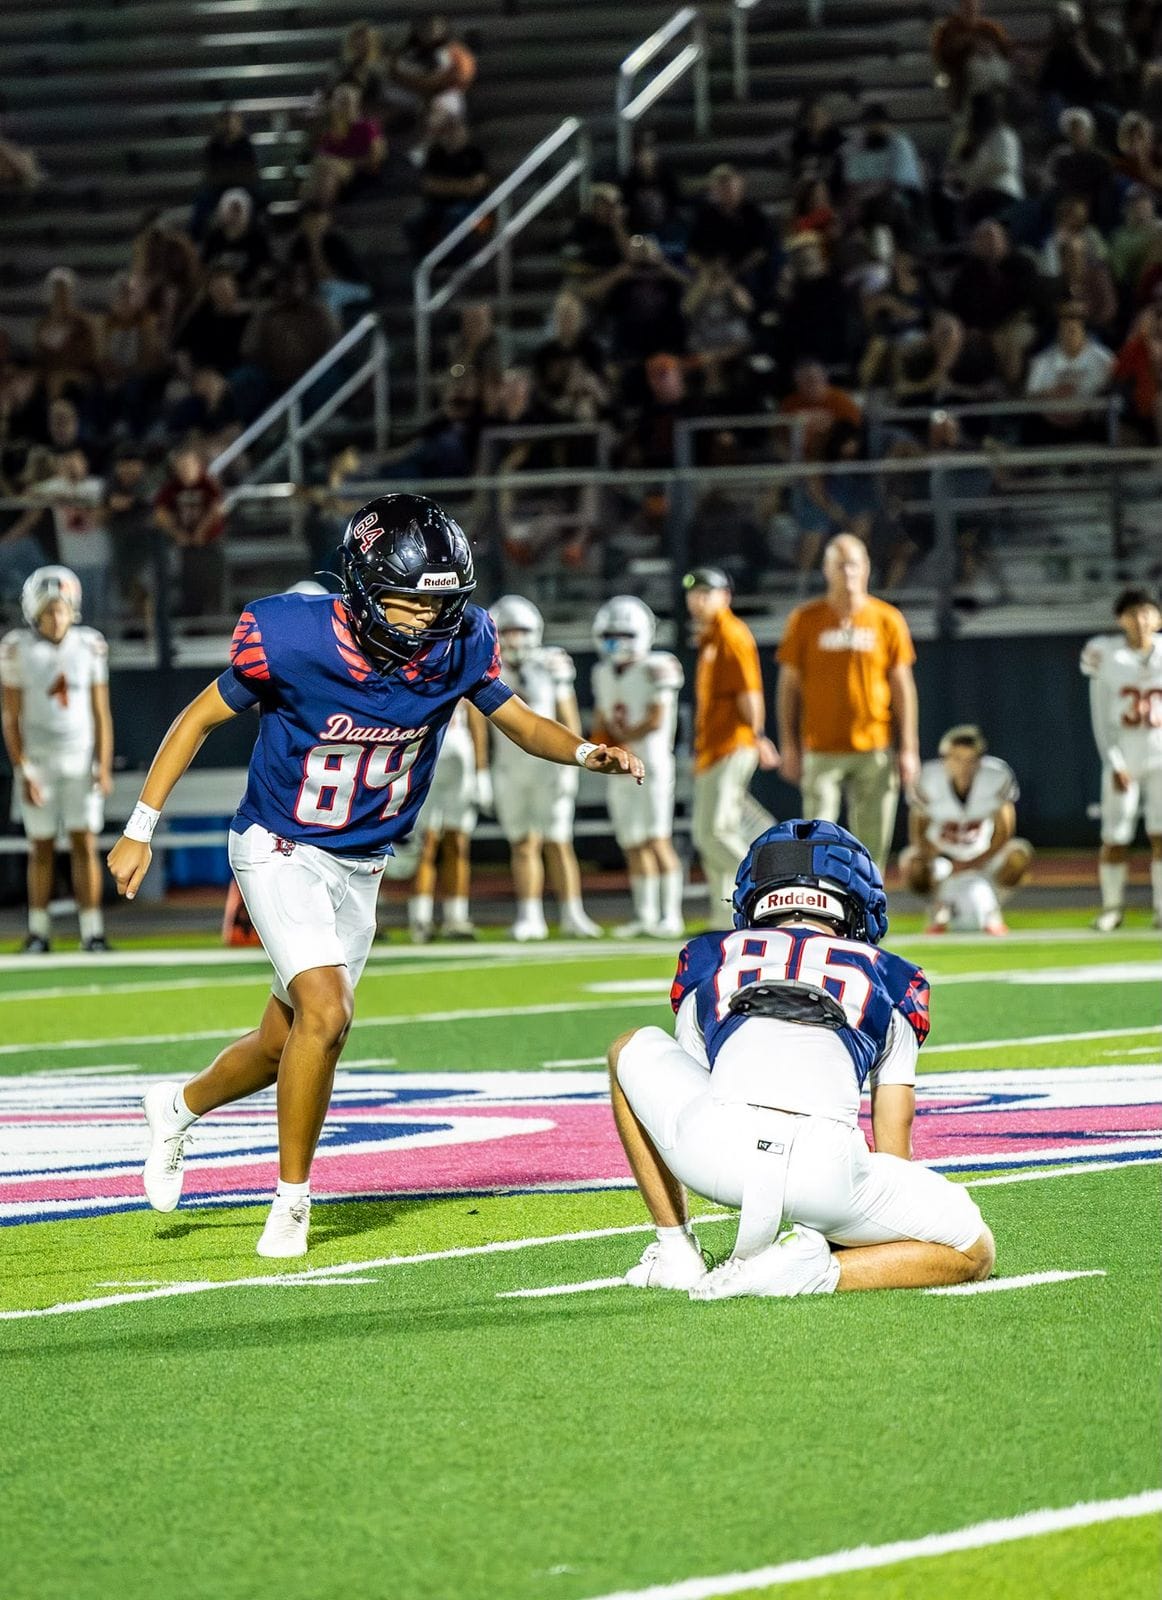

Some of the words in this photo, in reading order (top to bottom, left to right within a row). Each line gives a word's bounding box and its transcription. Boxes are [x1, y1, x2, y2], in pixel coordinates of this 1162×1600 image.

[353, 512, 385, 554] 84
[424, 577, 457, 587] Riddell
[320, 714, 430, 742] Dawson
[293, 739, 425, 830] 84
[767, 892, 828, 909] Riddell
[714, 928, 880, 1029] 86
